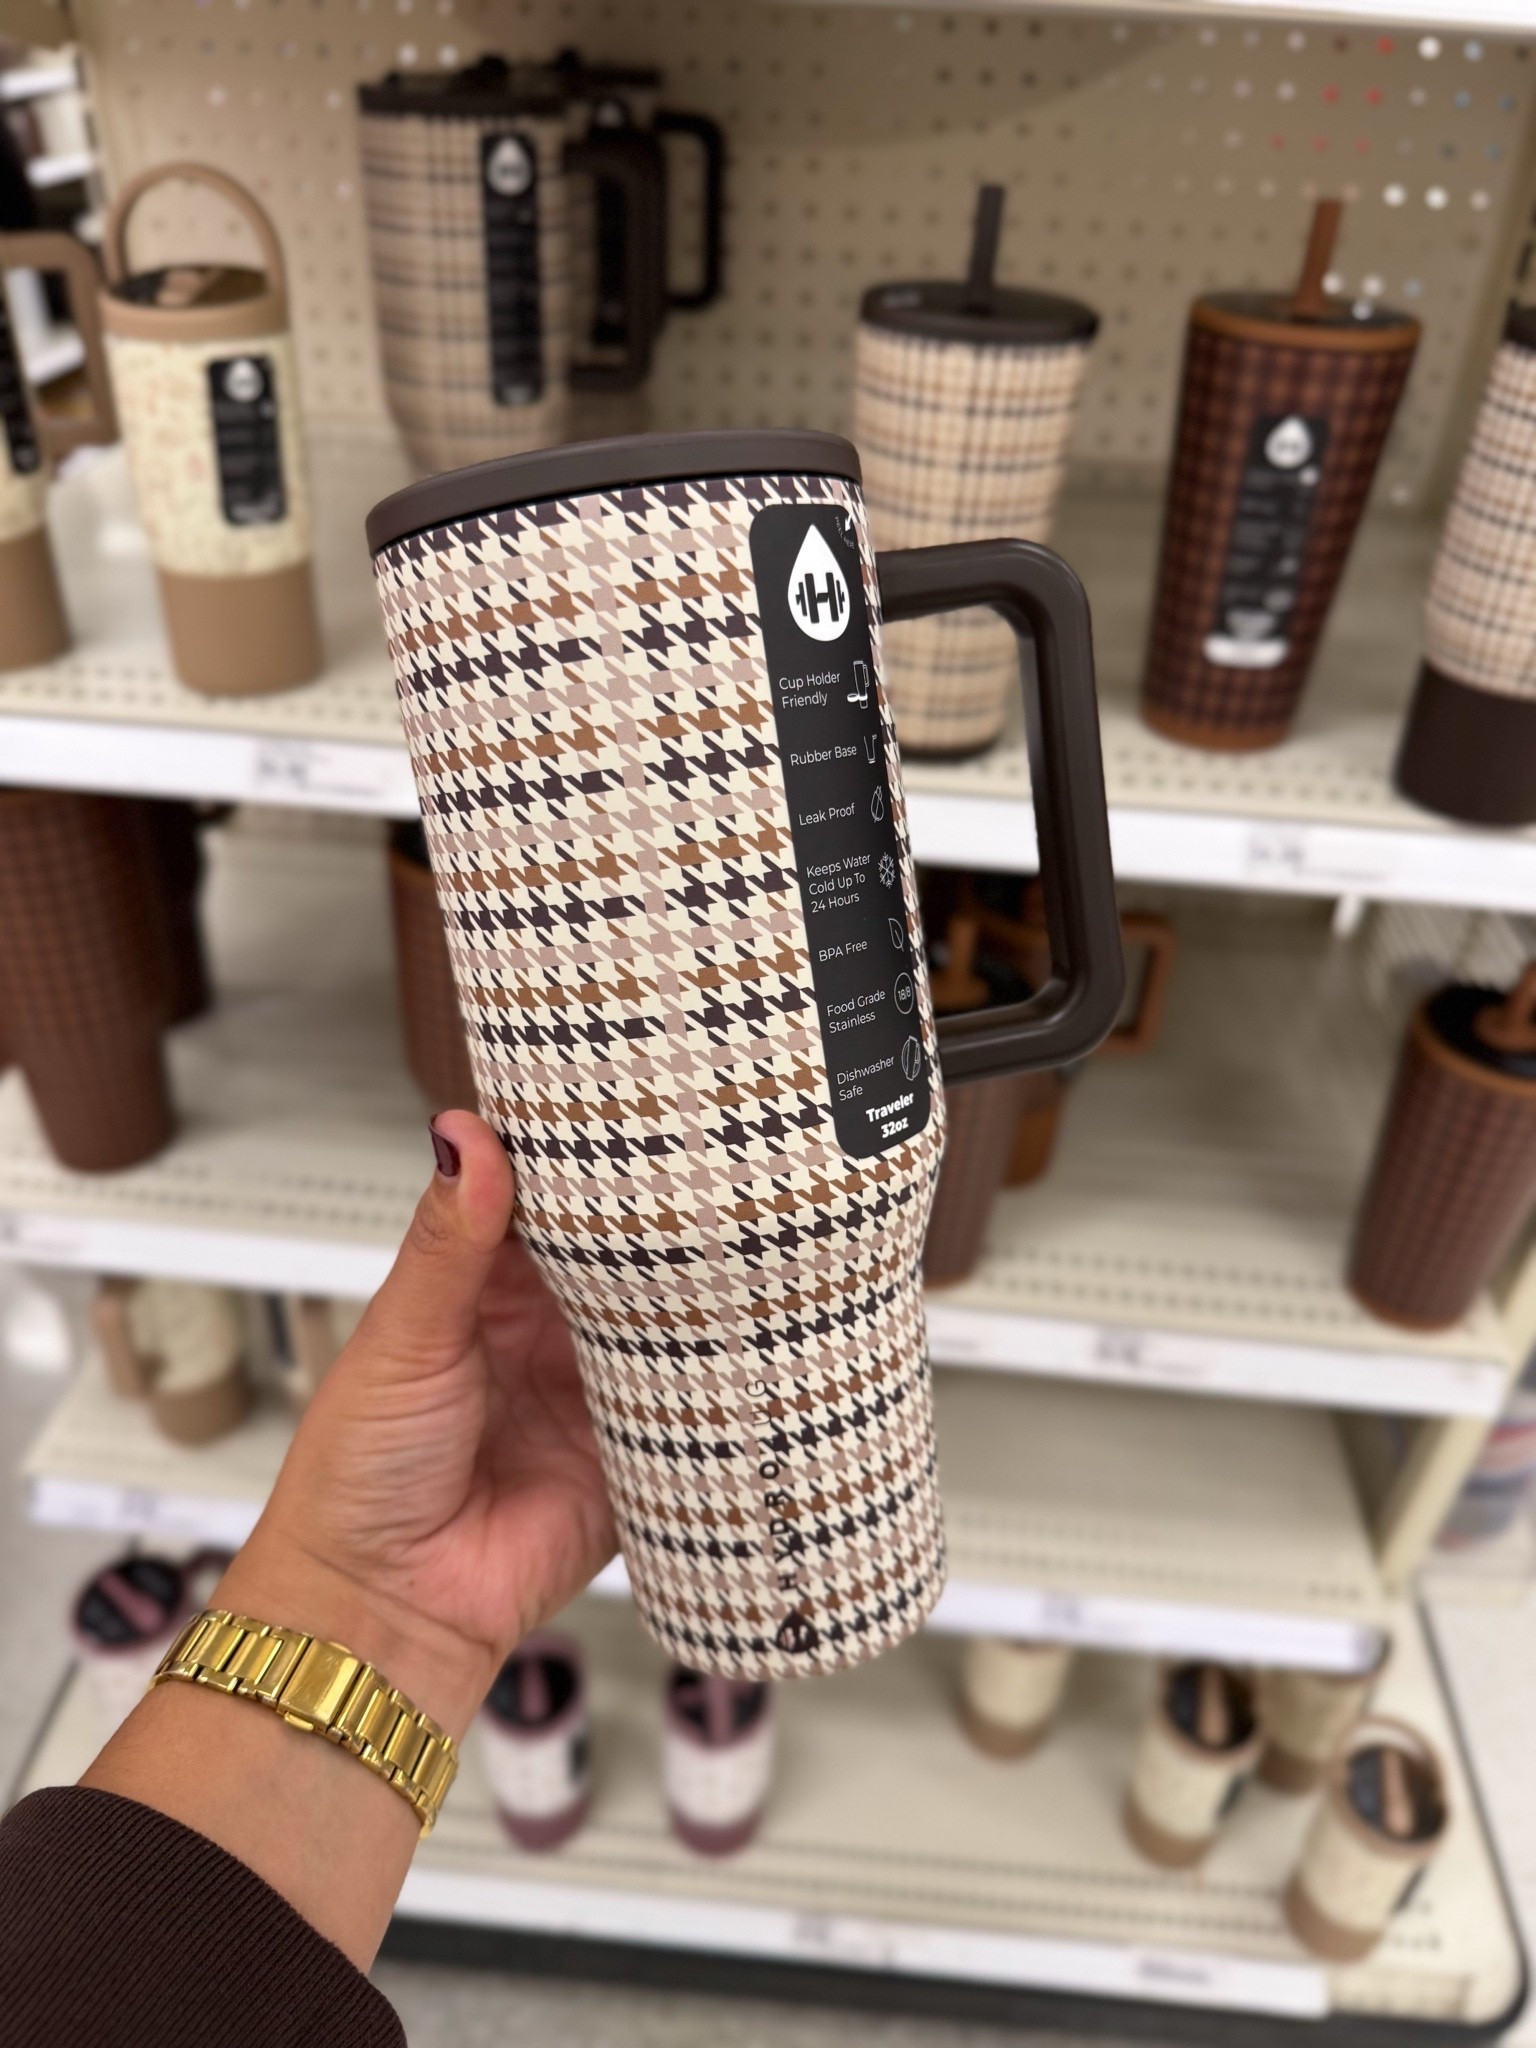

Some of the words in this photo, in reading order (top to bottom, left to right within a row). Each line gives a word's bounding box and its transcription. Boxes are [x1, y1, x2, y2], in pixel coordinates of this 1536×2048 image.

[780, 677, 804, 691] Cup
[806, 671, 840, 687] Holder
[782, 691, 828, 709] Friendly
[790, 749, 832, 766] Rubber
[834, 745, 857, 759] Base
[799, 809, 827, 826] Leak
[828, 802, 855, 820] Proof
[806, 862, 842, 878] Keeps
[842, 854, 871, 870] Water
[808, 878, 835, 896] Cold
[837, 876, 853, 890] Up
[853, 872, 866, 884] To
[810, 899, 826, 913] 24
[828, 892, 860, 909] Hours
[818, 946, 844, 962] BPA
[845, 940, 868, 955] Free
[826, 998, 855, 1017] Food
[857, 989, 886, 1008] Grade
[828, 1011, 876, 1034] Stainless
[836, 1056, 895, 1085] Dishwasher
[838, 1084, 863, 1101] Safe
[865, 1092, 914, 1123] Traveler
[880, 1117, 909, 1139] 32oz
